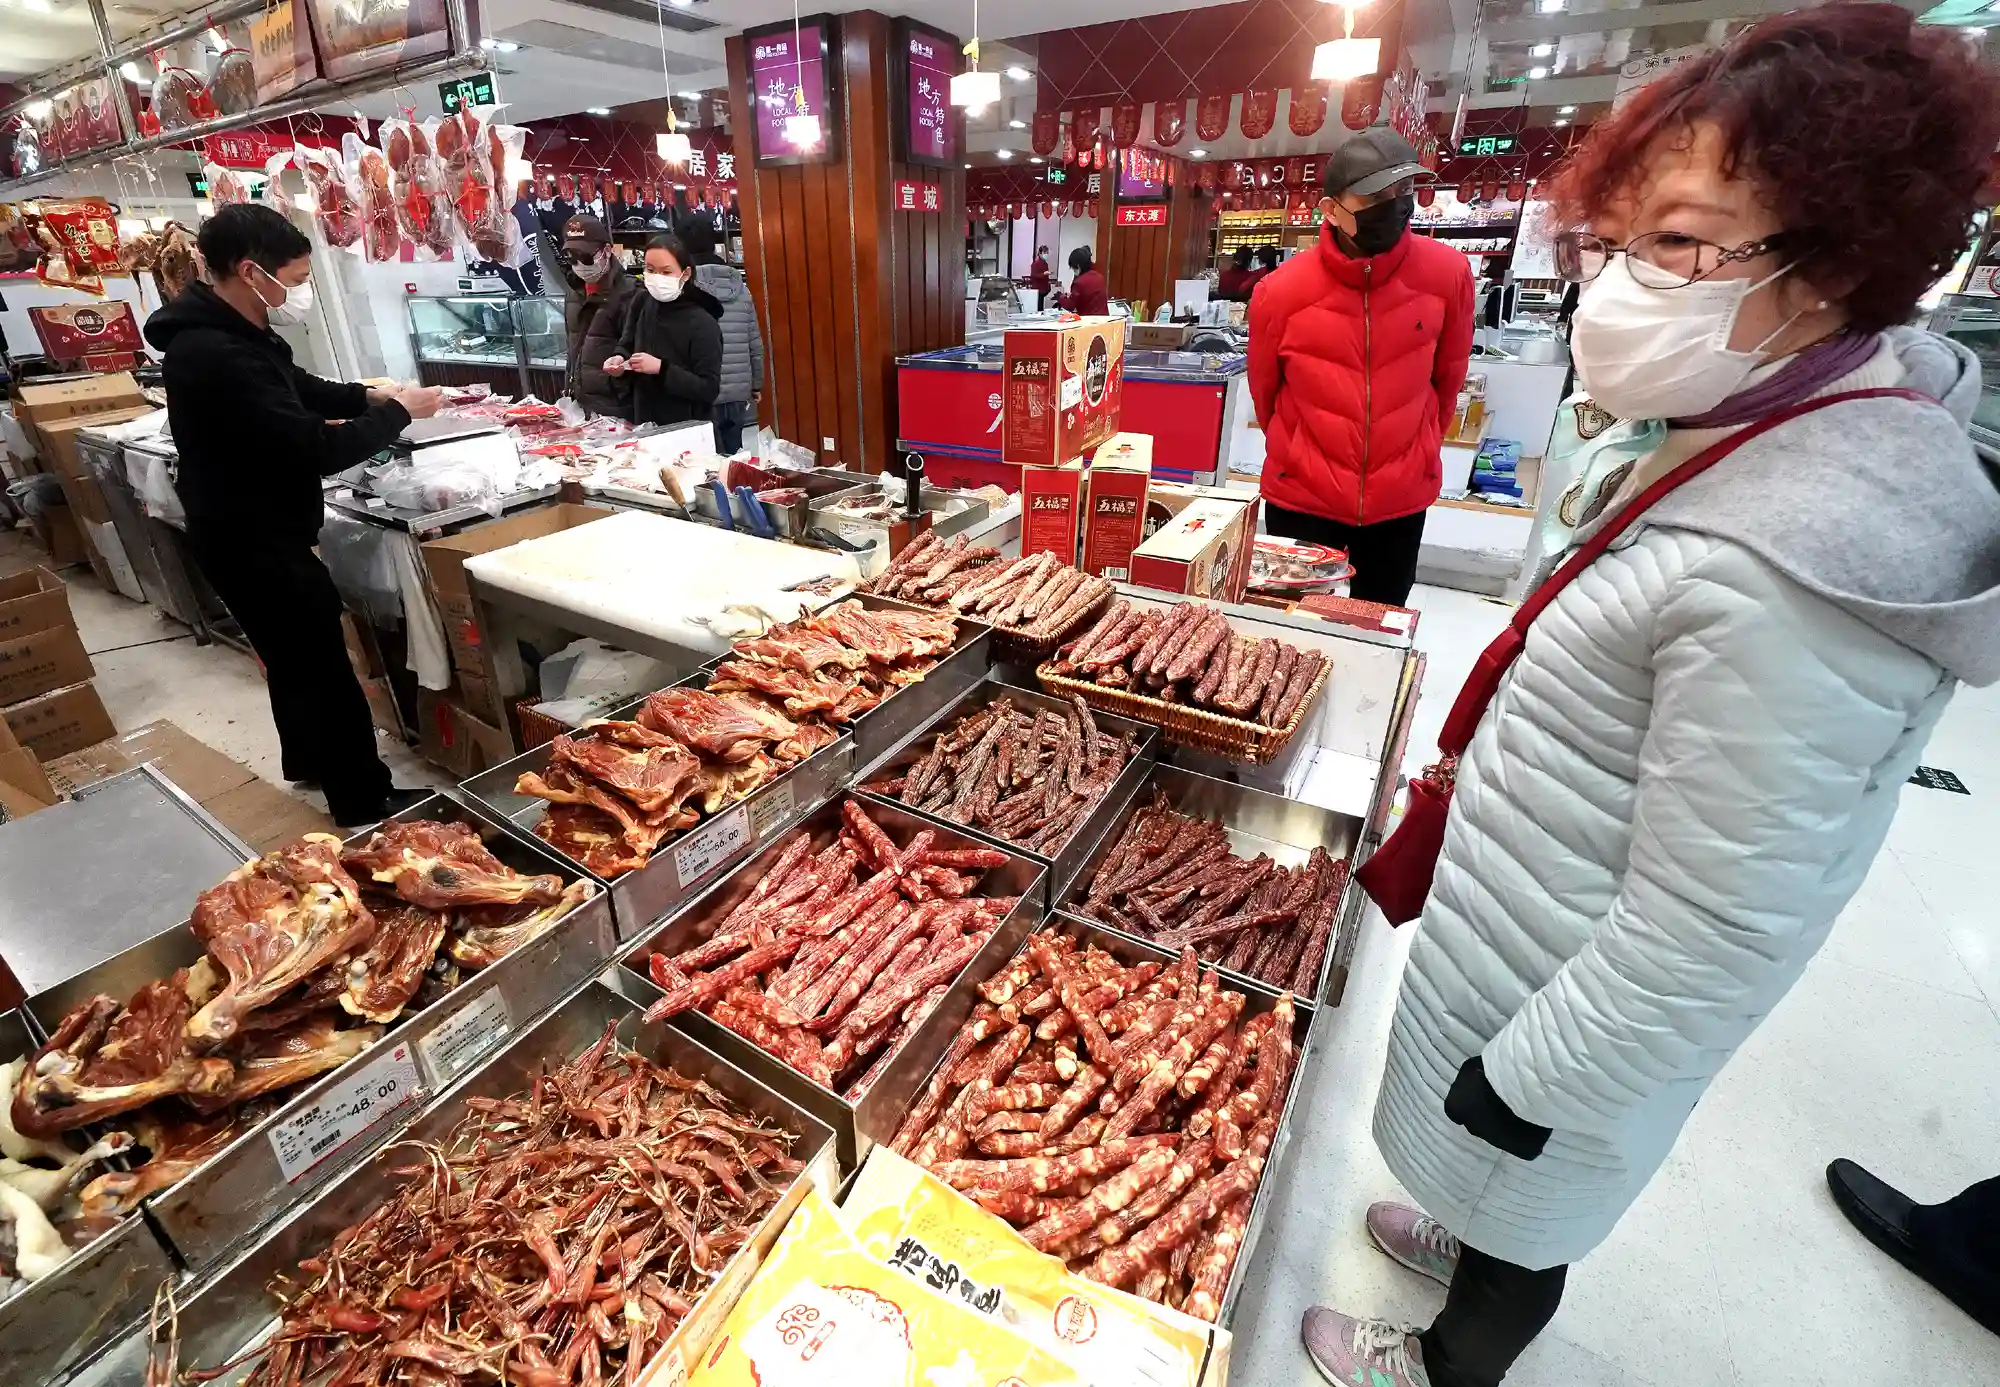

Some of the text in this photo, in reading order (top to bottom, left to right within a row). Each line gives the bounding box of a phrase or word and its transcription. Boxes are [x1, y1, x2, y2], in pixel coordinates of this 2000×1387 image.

[772, 107, 793, 117] LOCAL
[918, 76, 945, 145] 地方特色
[689, 149, 736, 179] 居家
[901, 183, 938, 210] 宣城
[1012, 360, 1041, 376] 五福
[1032, 496, 1060, 510] 五福
[1096, 498, 1126, 513] 五福
[351, 1079, 396, 1116] 48.00
